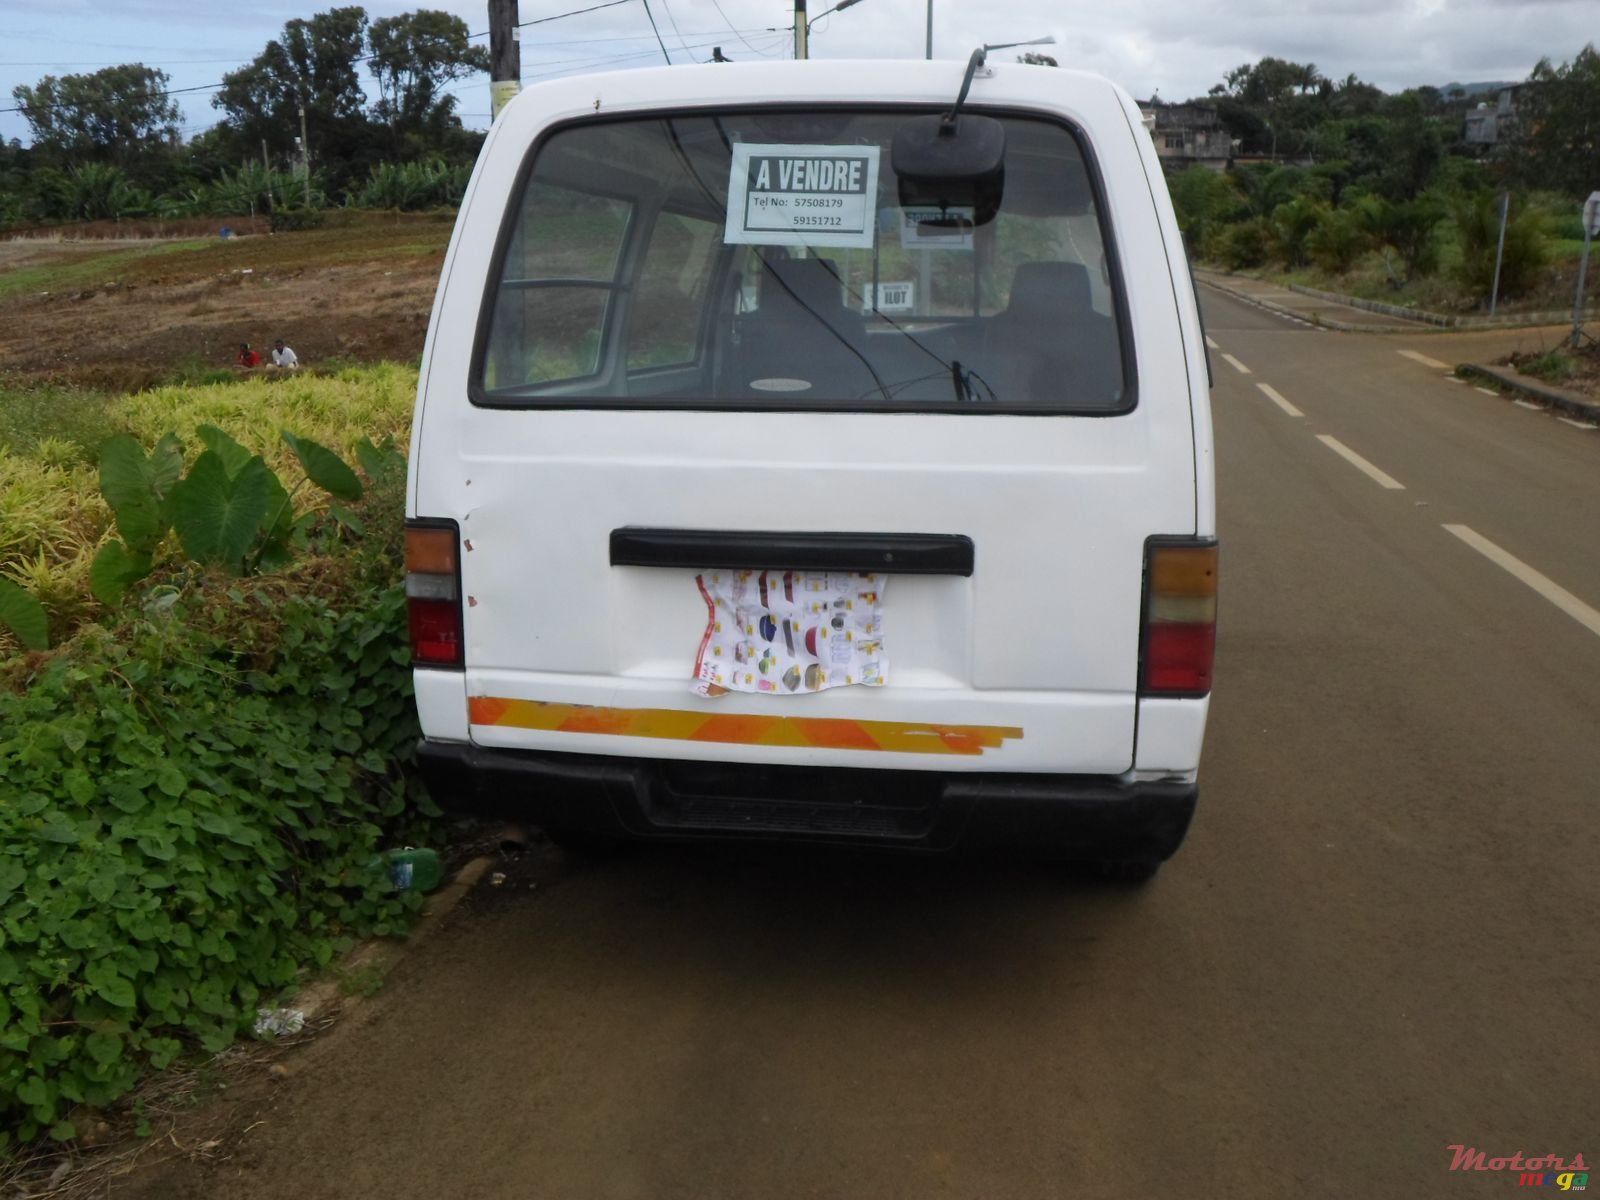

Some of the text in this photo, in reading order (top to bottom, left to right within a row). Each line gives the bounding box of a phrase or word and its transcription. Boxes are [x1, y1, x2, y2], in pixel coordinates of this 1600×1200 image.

[756, 160, 861, 191] A VENDRE
[754, 197, 843, 208] Tel No: 57508179
[793, 215, 842, 226] 59151712
